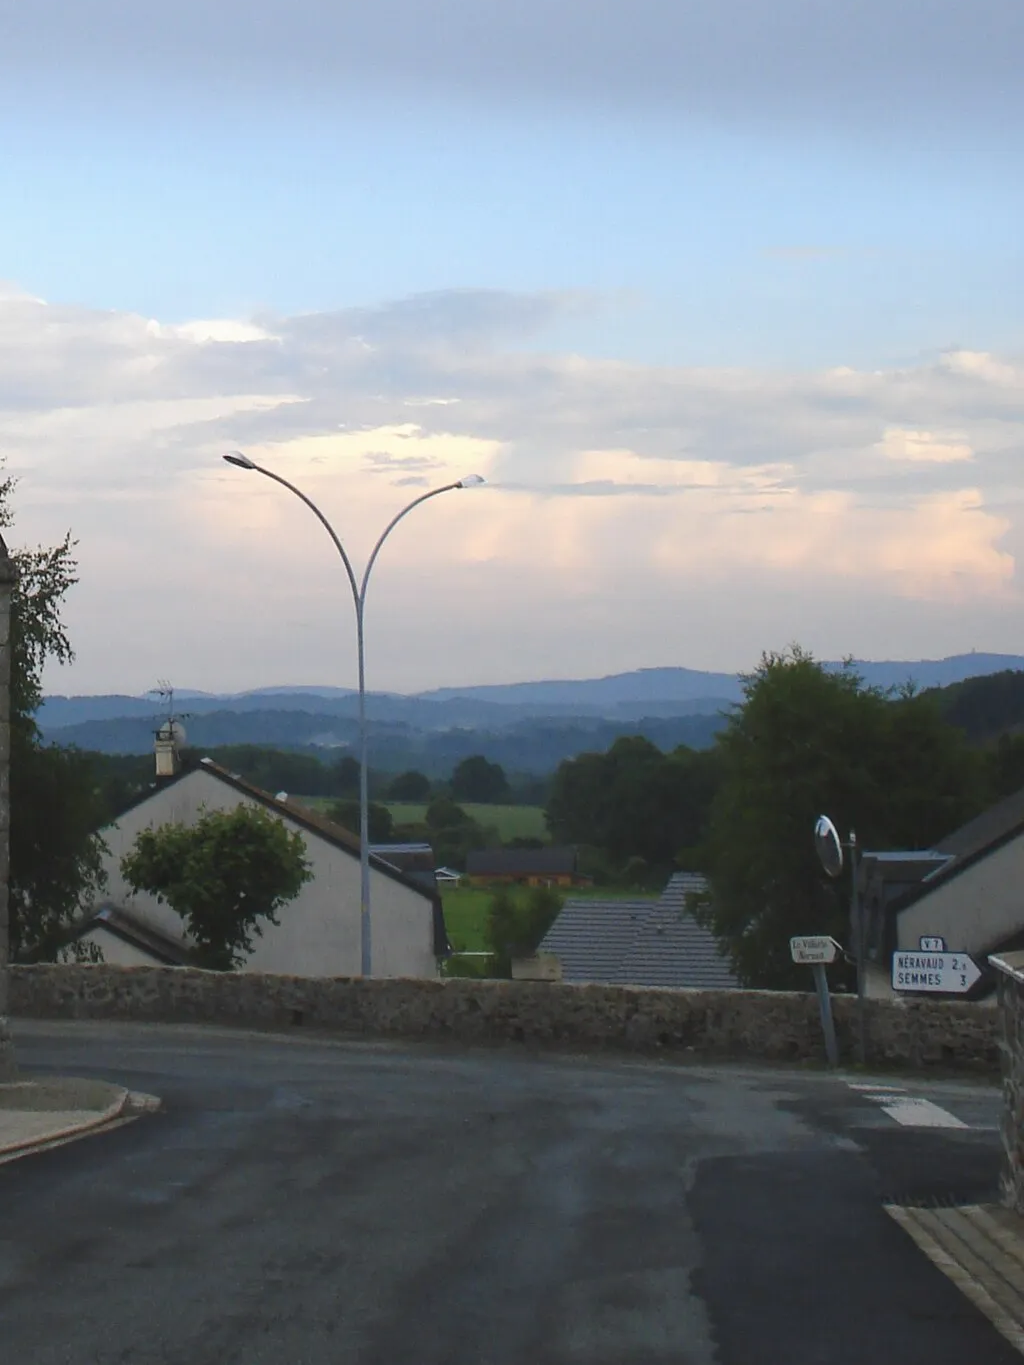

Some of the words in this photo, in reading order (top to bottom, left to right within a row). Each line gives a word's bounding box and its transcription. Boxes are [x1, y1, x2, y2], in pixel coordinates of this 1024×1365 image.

[924, 940, 930, 948] V
[934, 940, 939, 948] 7
[898, 955, 944, 970] NÉRAVAUD
[898, 973, 942, 986] SEMMES
[960, 975, 967, 987] 3
